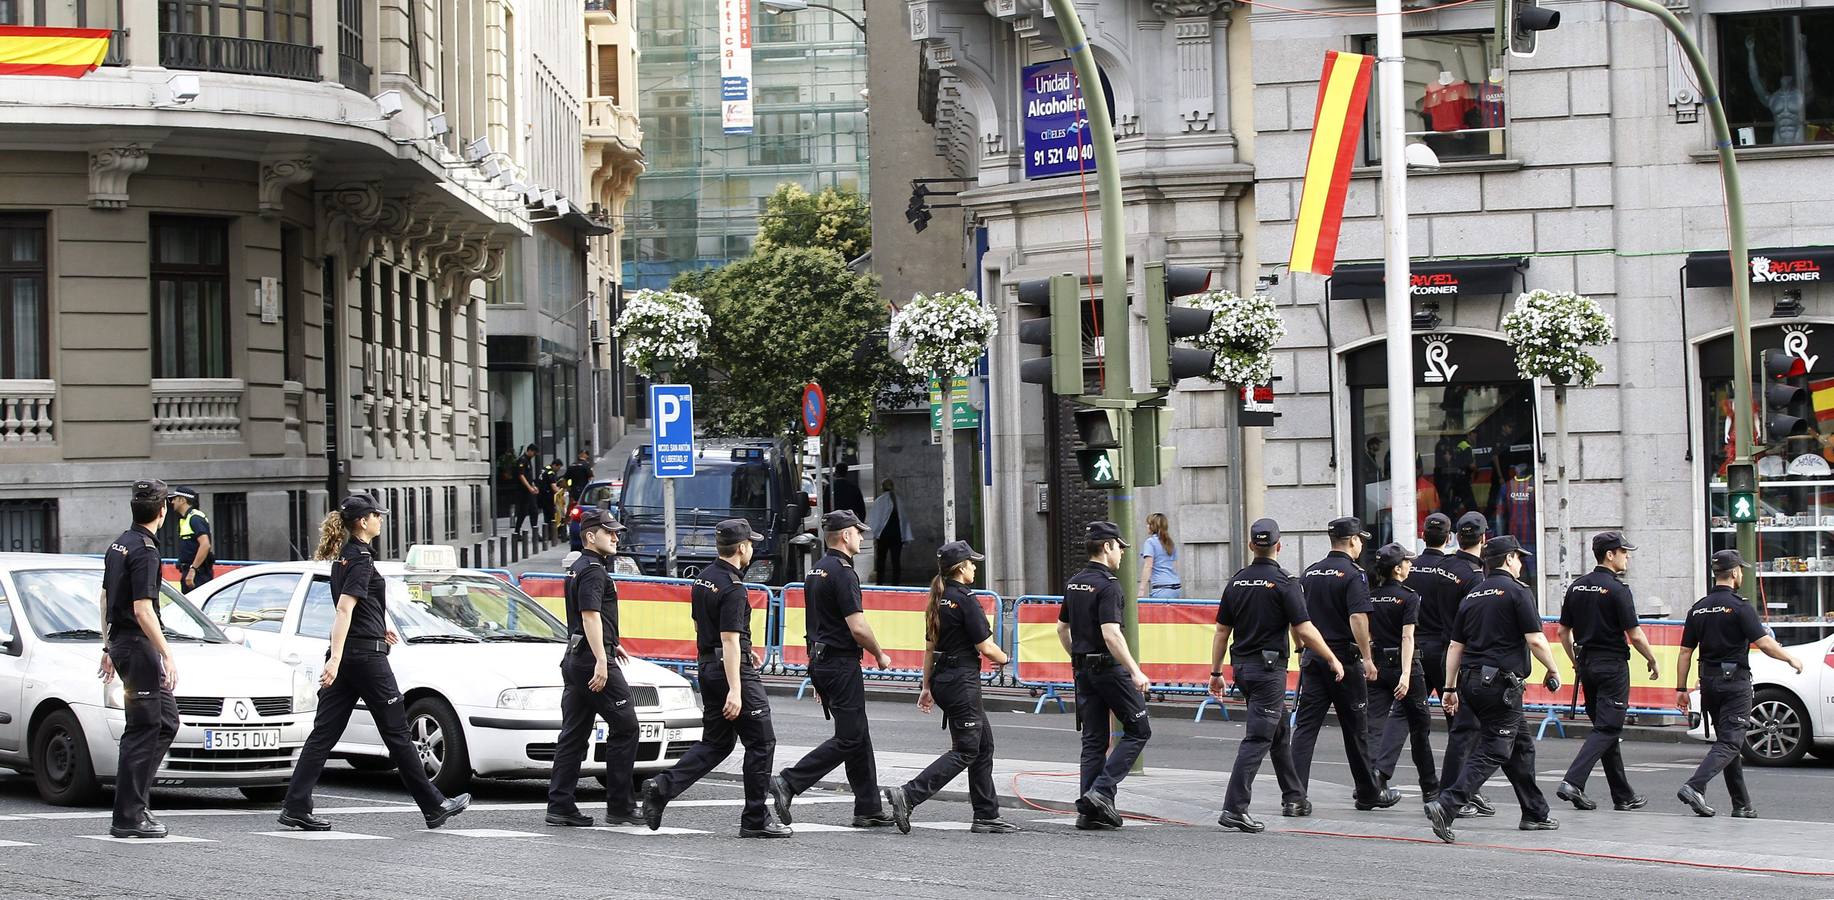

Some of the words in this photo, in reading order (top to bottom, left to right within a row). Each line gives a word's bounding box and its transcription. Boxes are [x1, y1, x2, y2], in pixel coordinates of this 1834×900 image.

[1035, 71, 1071, 95] Unidad
[1041, 128, 1067, 141] CIBELES
[1034, 150, 1045, 166] 91
[1048, 147, 1063, 165] 521
[1066, 145, 1079, 162] 40
[1081, 143, 1093, 160] 40
[1774, 271, 1821, 282] CORNER
[1414, 285, 1458, 295] CORNER
[658, 394, 680, 437] P
[1306, 569, 1339, 578] POLICIA
[1067, 583, 1091, 591] POLICIA
[1233, 579, 1268, 587] POLICIA
[1466, 588, 1499, 600] POLICIA
[1693, 606, 1726, 617] POLICIA
[640, 723, 660, 738] FBW
[669, 730, 681, 740] SP
[215, 731, 247, 748] 5151
[253, 731, 276, 748] DVJ
